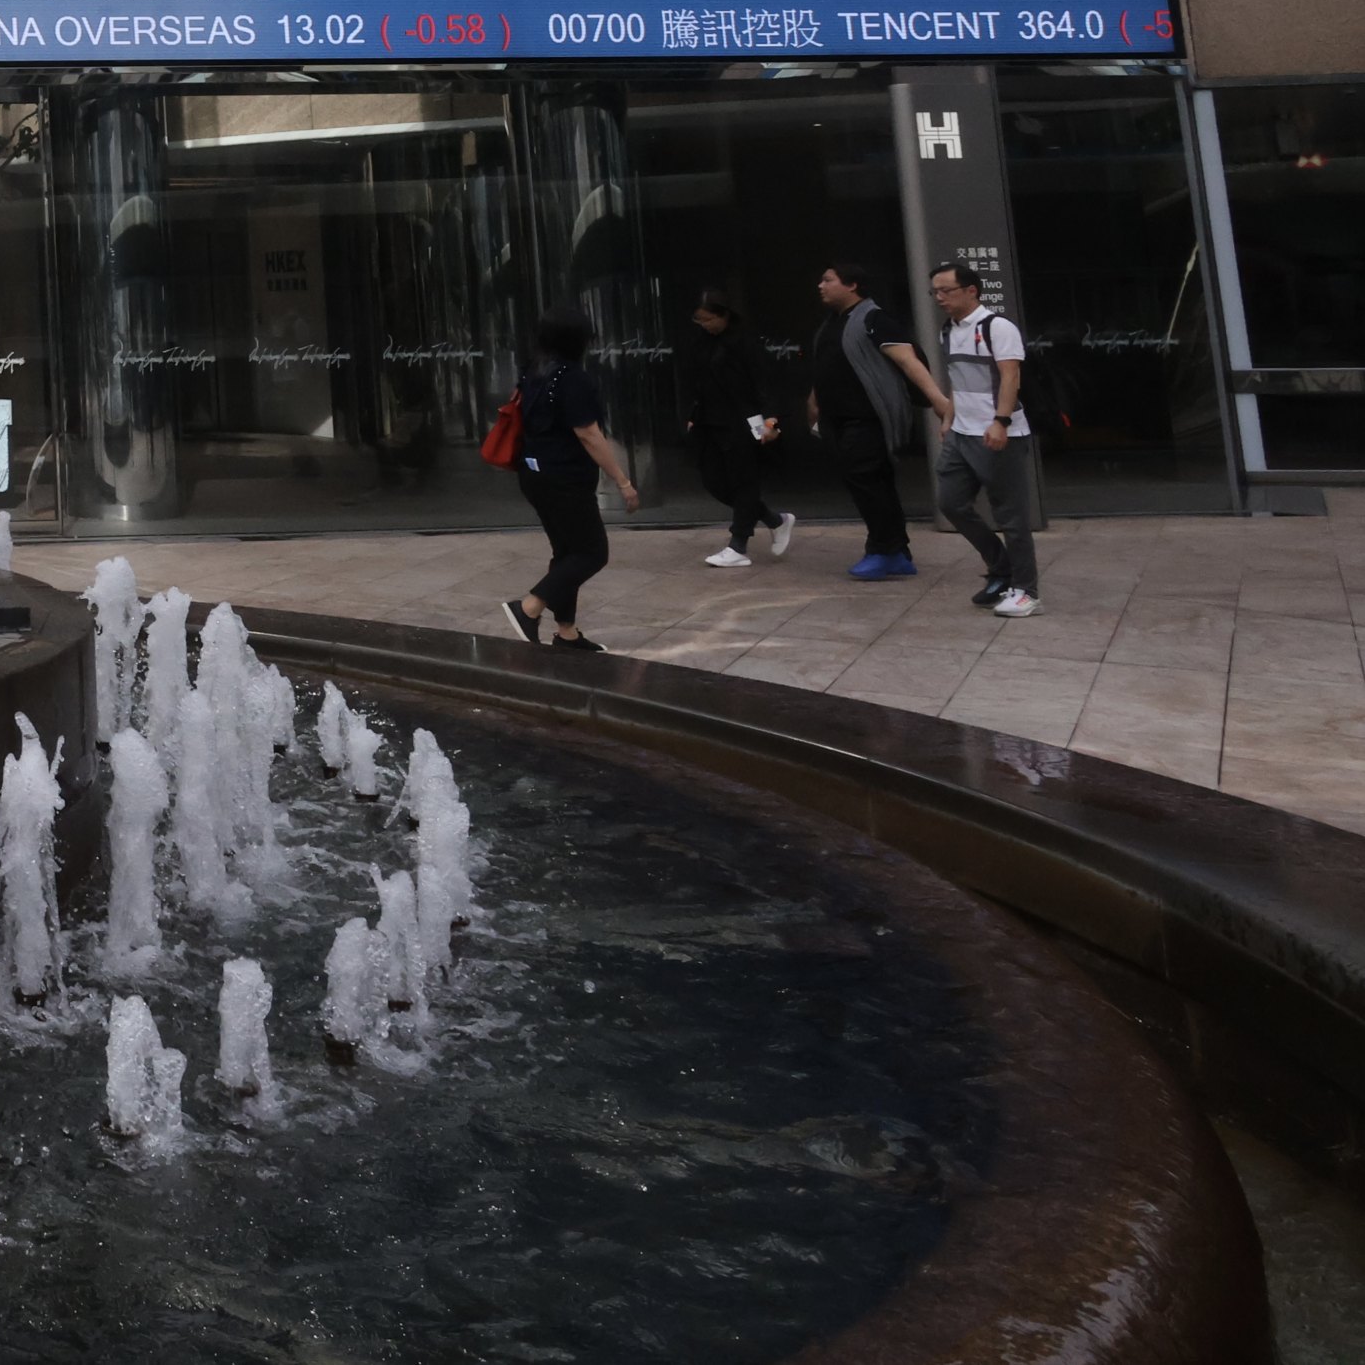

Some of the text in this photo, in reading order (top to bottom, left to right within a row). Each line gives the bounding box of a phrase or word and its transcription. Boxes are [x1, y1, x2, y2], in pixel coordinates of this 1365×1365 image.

[55, 15, 256, 46] OVERSEAS
[277, 14, 365, 45] 13.02
[549, 13, 645, 43] 00700
[661, 9, 824, 49] 騰訊控股
[837, 12, 1000, 40] TENCENT
[1018, 10, 1103, 39] 364.0
[980, 278, 1003, 289] Two
